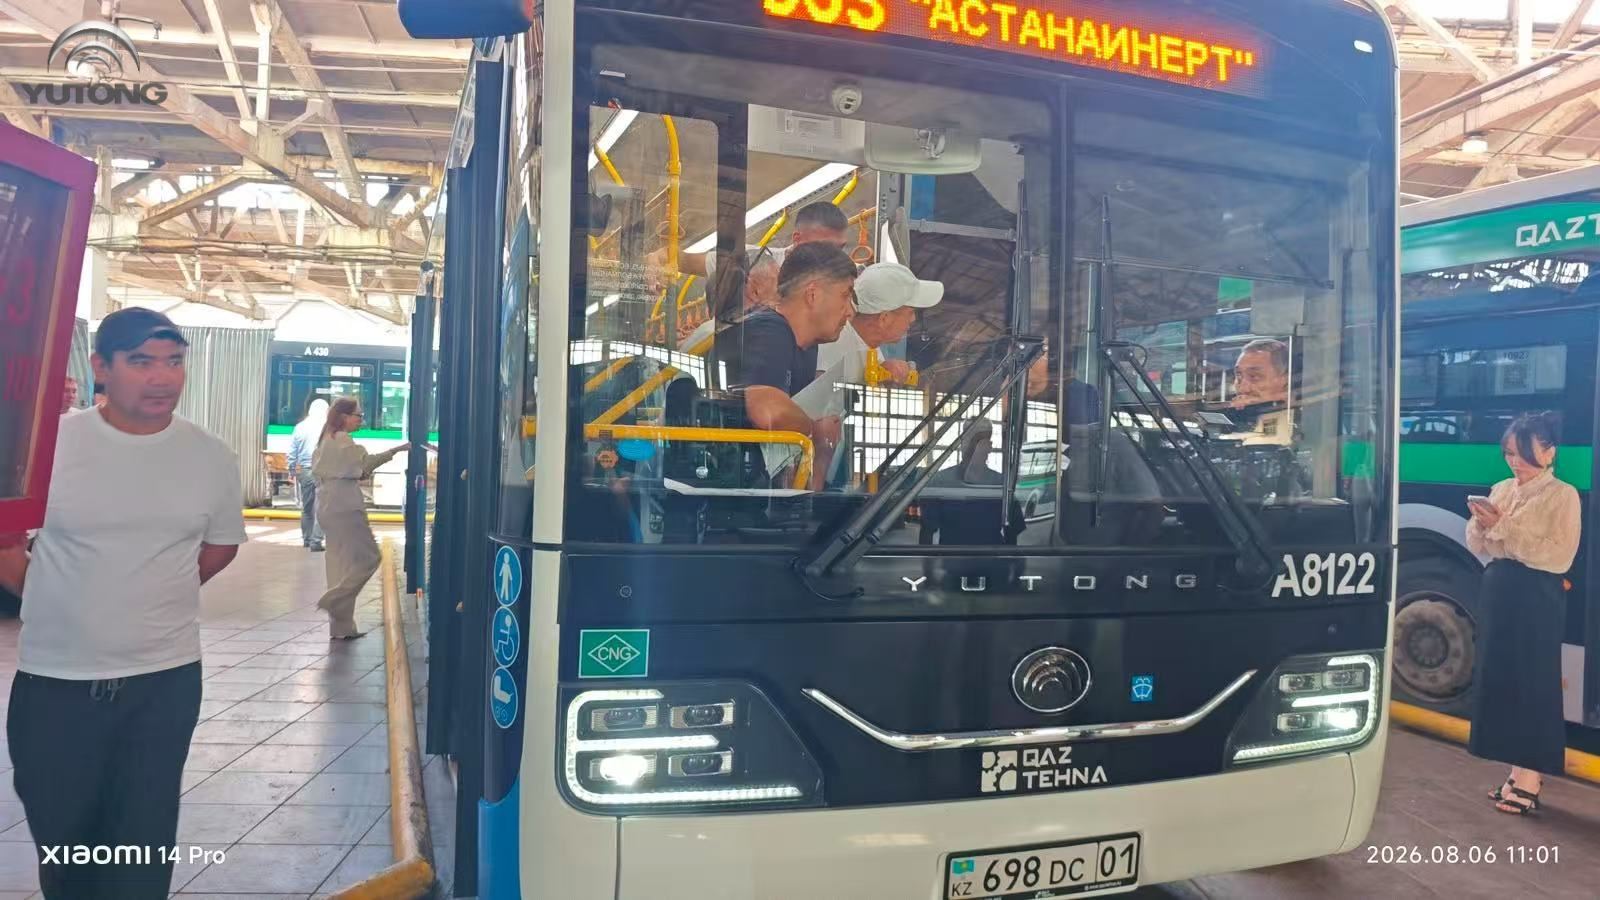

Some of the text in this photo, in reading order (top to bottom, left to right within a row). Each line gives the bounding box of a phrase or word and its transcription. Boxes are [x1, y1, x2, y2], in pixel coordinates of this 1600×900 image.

[911, 0, 1254, 82] АСТАНАИНЕРТ"
[902, 573, 1197, 592] YUTONG
[1271, 552, 1376, 597] A8122
[598, 646, 632, 661] CNG
[1022, 746, 1072, 767] QAZ
[1022, 766, 1108, 789] TEHNA
[983, 843, 1134, 892] 698 DC 01
[952, 882, 972, 896] KZ
